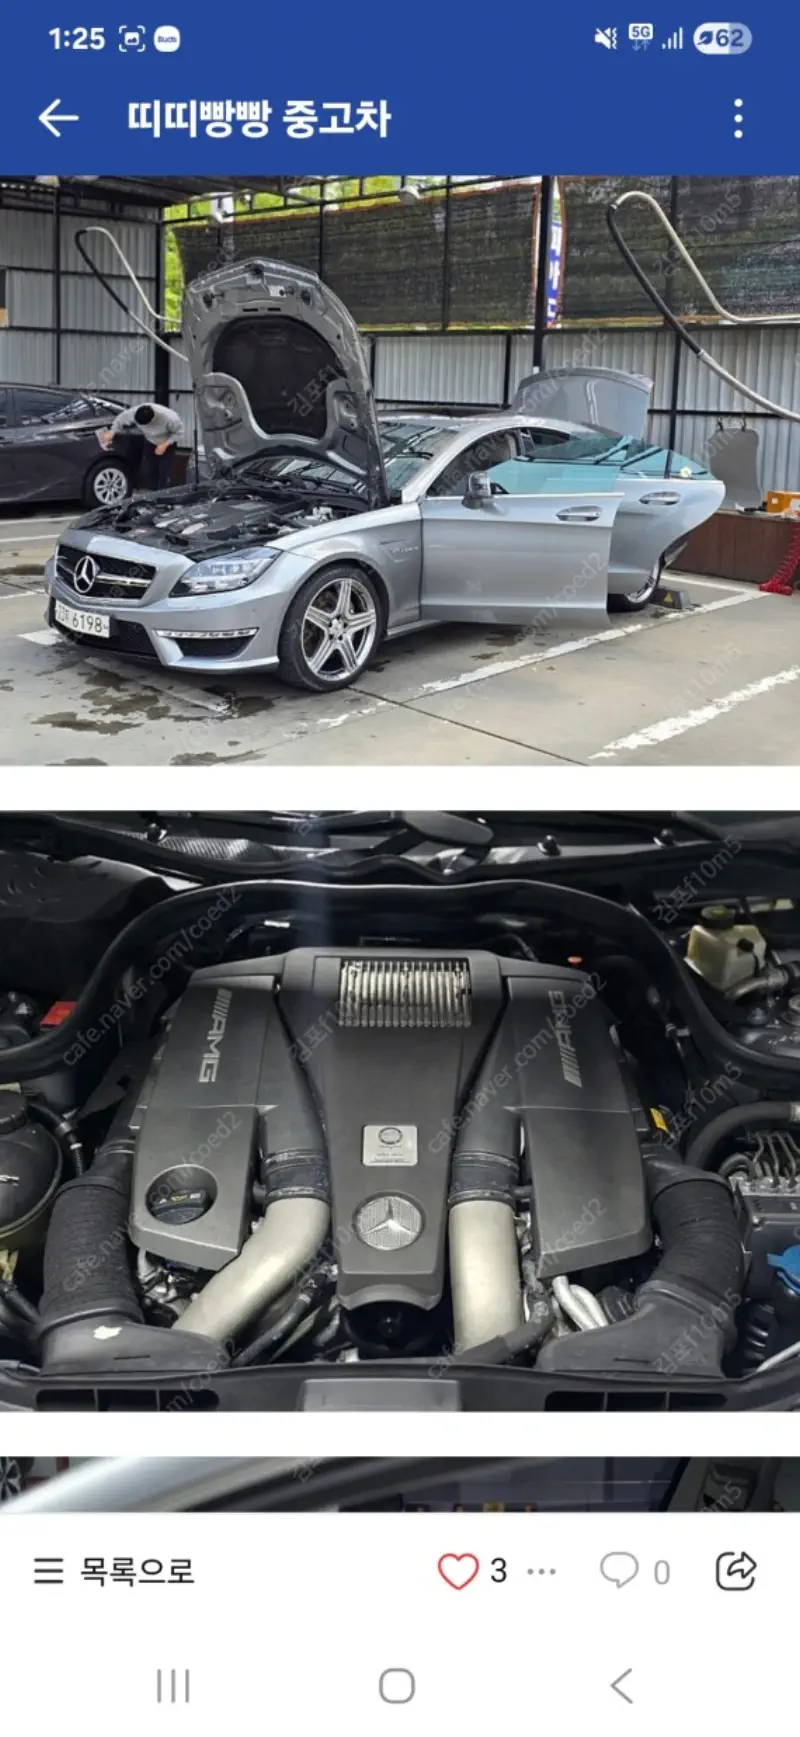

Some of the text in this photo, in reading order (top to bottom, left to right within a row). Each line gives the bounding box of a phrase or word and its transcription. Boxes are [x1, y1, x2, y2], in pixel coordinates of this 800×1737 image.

[49, 27, 106, 50] 1:25
[631, 25, 652, 38] 5G
[715, 28, 745, 47] 62
[128, 99, 392, 139] 띠띠빵빵 중고차
[72, 612, 103, 633] 6198
[80, 1557, 195, 1588] 목록으로
[490, 1557, 508, 1583] 3
[654, 1560, 670, 1585] 0
